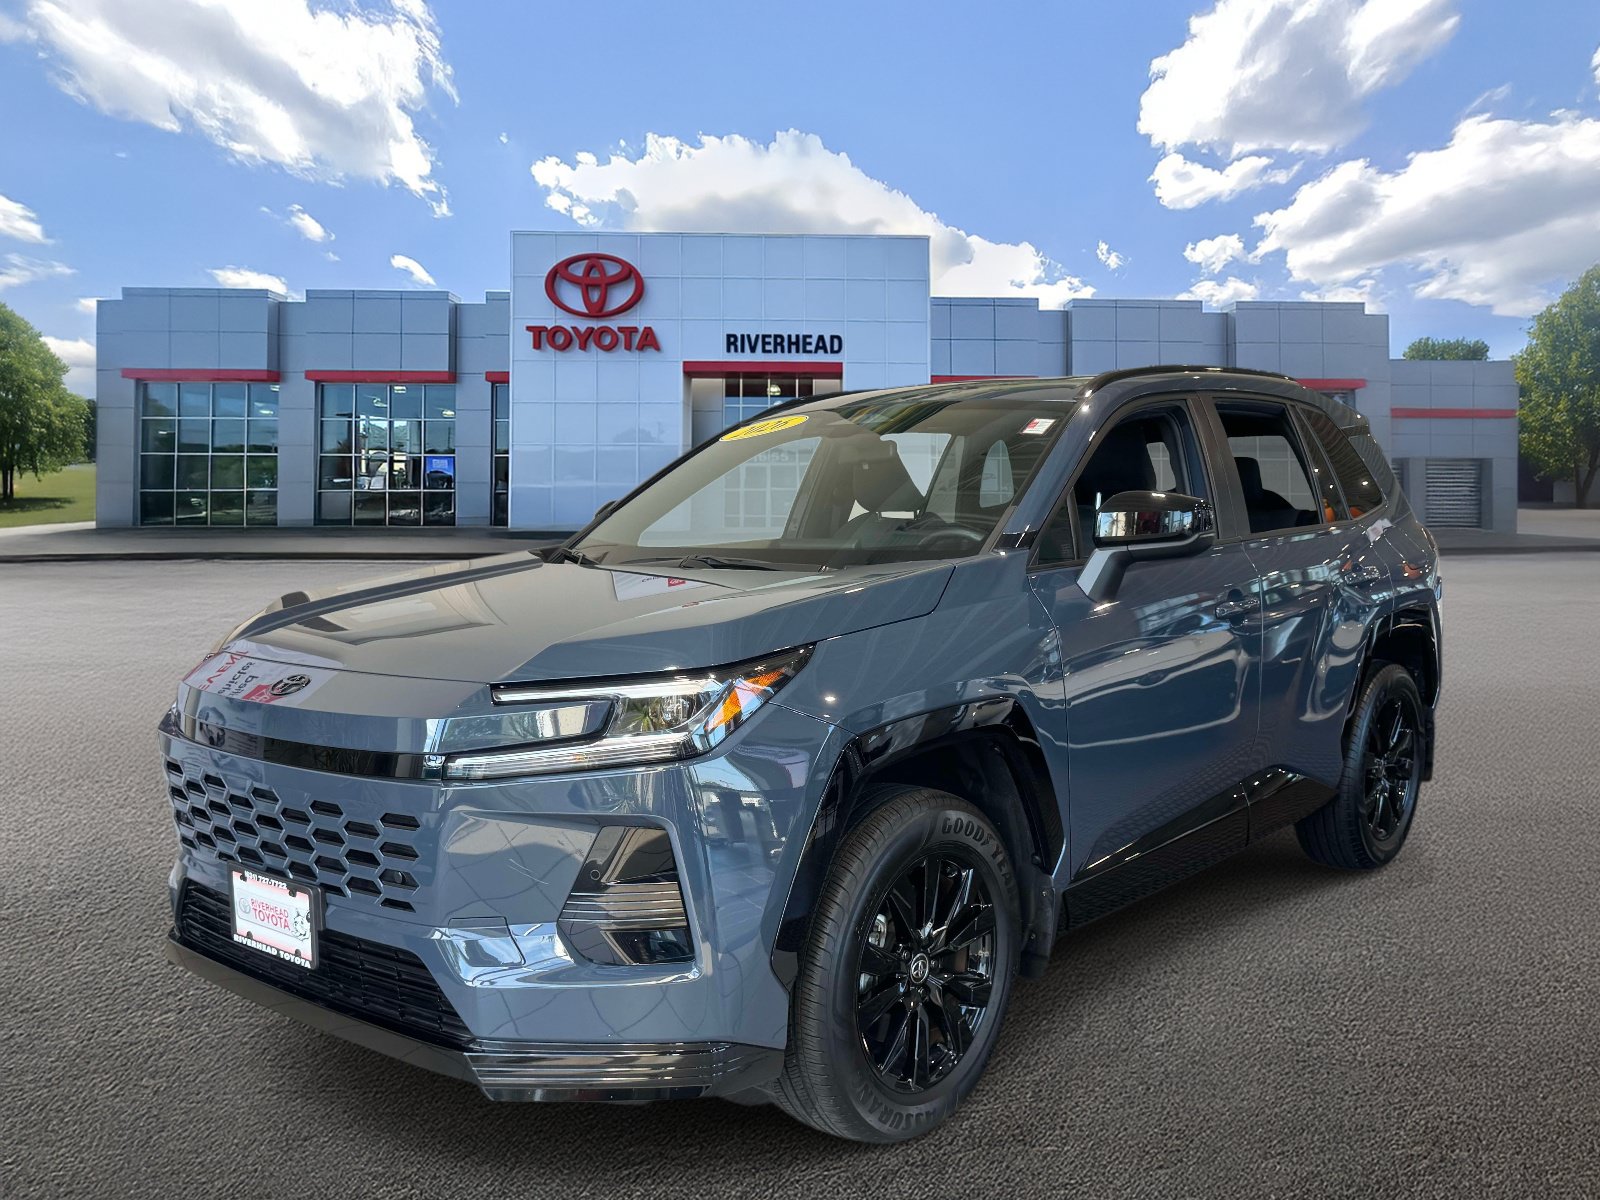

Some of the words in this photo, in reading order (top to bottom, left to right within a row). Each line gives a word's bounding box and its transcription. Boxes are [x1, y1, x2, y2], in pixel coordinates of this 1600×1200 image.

[525, 326, 661, 352] TOYOTA
[726, 333, 844, 354] RIVERHEAD
[250, 898, 289, 919] RIVERHEAD
[252, 907, 291, 931] TOYOTA
[233, 933, 278, 956] RIVERHEAD
[279, 951, 312, 969] TOYOTA
